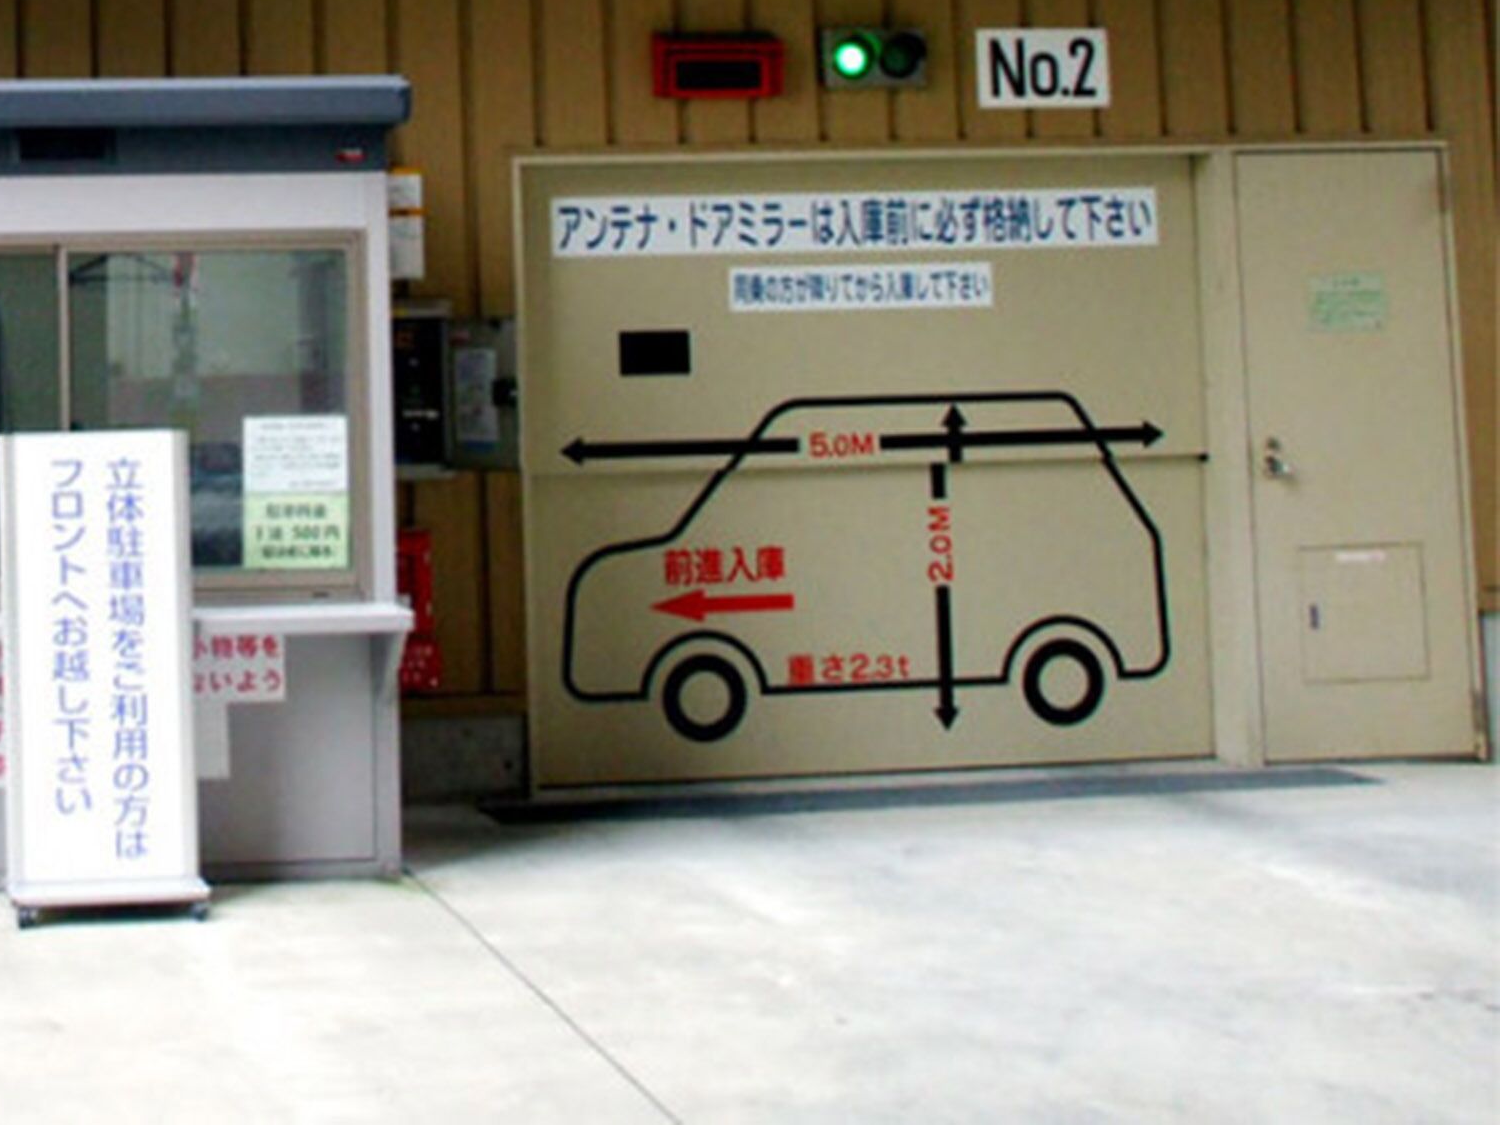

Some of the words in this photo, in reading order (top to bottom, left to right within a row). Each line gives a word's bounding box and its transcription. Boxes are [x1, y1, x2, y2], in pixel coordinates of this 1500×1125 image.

[987, 37, 1098, 100] No.2
[556, 195, 1152, 251] アンテナ・ドアミラーは入庫前に必ず格納して下さい
[808, 433, 875, 458] 5.0M
[663, 546, 786, 586] 前進入庫
[927, 506, 955, 582] 2.0M
[51, 459, 92, 815] フロントへお越し下さい
[105, 456, 149, 859] 立体駐車場をご利用の方は
